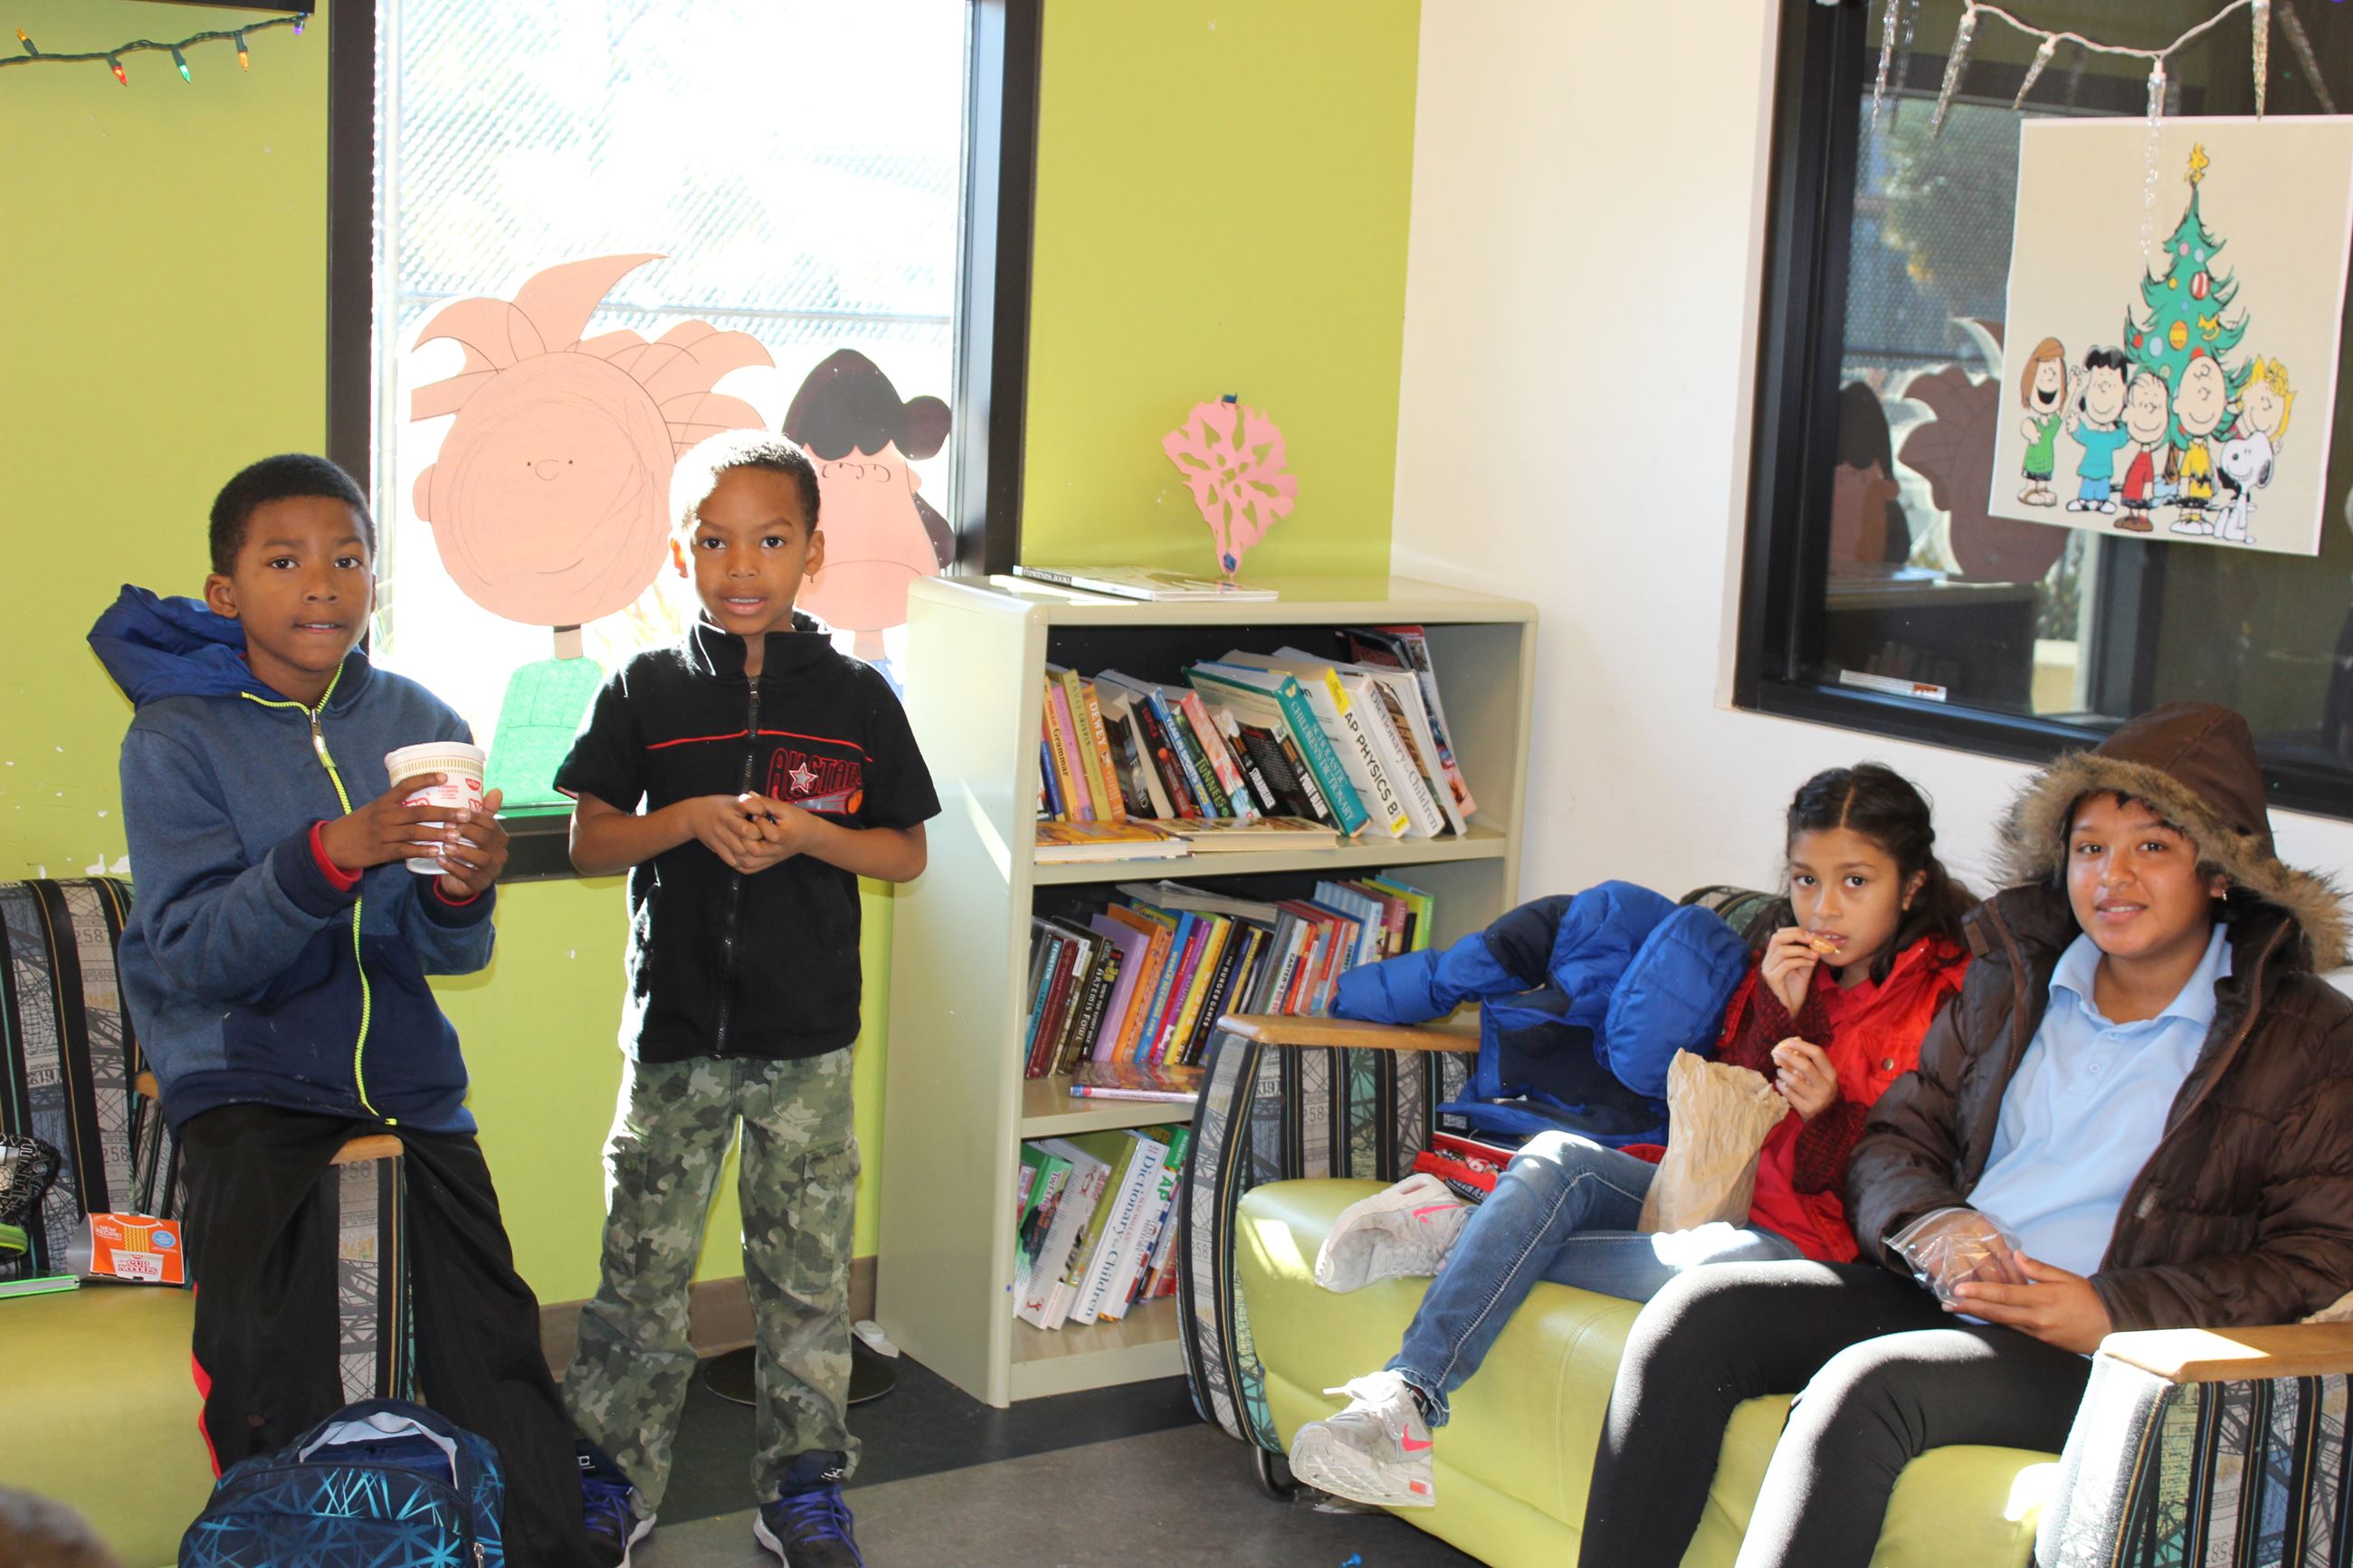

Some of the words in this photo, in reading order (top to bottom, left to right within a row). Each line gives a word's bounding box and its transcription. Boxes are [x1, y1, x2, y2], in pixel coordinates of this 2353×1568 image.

[1089, 701, 1107, 746] DEWEY
[1053, 728, 1068, 777] Grammar
[1166, 716, 1177, 740] YEAR
[1180, 747, 1198, 783] SPORTS
[1313, 723, 1348, 787] SCHOLASTIC
[1344, 712, 1358, 731] AP
[1356, 735, 1391, 802] PHYSICS
[1387, 802, 1398, 815] B
[1369, 690, 1405, 764] Dictionary
[1408, 770, 1438, 830] Children
[1195, 755, 1227, 807] TUNNELS
[1319, 759, 1355, 821] DICTIONARY
[1044, 944, 1060, 980] FEINSTEIN
[1167, 951, 1178, 979] WORLD
[1215, 965, 1229, 998] HUNGER
[1279, 953, 1295, 991] CARTER'S
[1085, 967, 1104, 1011] ARTEMIS
[1155, 979, 1170, 1018] RECORDS
[1174, 974, 1194, 1013] BOUNCE
[1076, 1010, 1091, 1041] FOWL
[1203, 1000, 1215, 1027] GAMES
[1111, 1155, 1157, 1240] Dictionary
[1157, 1175, 1173, 1201] AP
[1123, 1196, 1145, 1242] MACMILLAN
[1134, 1218, 1151, 1252] HISTORY
[127, 1259, 149, 1268] CUP
[1085, 1250, 1119, 1317] Children
